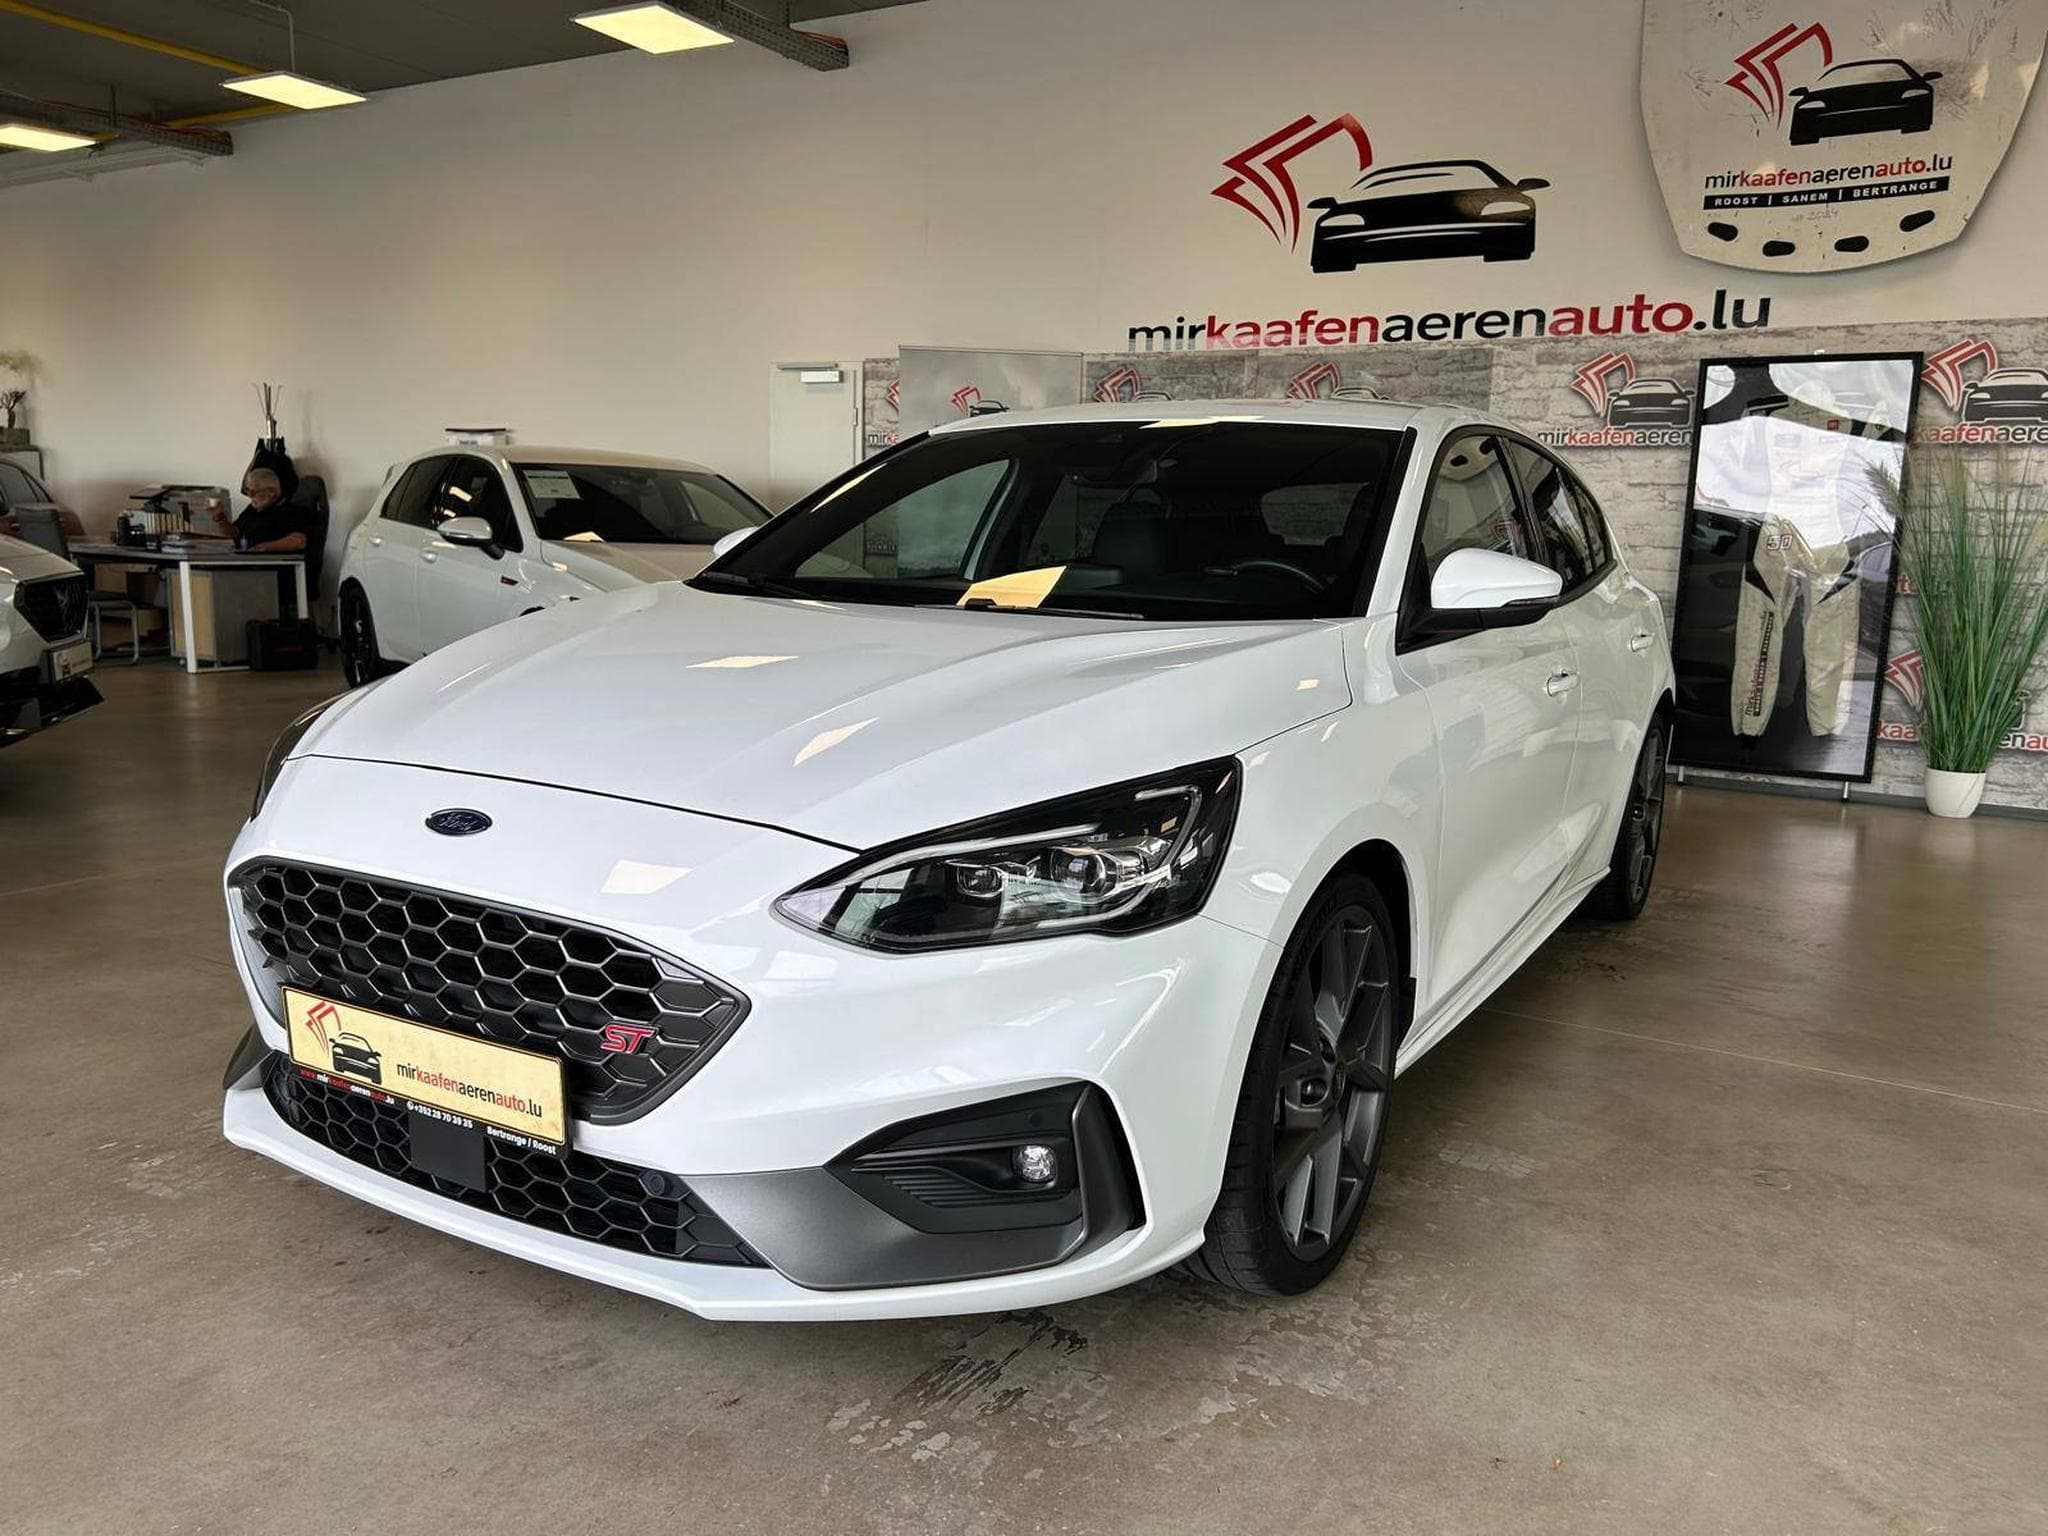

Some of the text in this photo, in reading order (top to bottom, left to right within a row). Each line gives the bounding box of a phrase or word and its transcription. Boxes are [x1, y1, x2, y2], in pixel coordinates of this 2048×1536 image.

[1705, 154, 1952, 189] mirkaafenaerenauto.lu
[1714, 196, 1758, 207] ROOST
[1782, 193, 1829, 204] SANEM
[1852, 180, 1938, 199] BERTRANGE
[1128, 289, 1771, 350] mirkaafenaerenauto.lu
[600, 1023, 656, 1055] ST
[397, 1063, 542, 1118] mirkaafenaerenauto.lu
[487, 1126, 527, 1147] Bertrange
[532, 1140, 557, 1156] Roost
